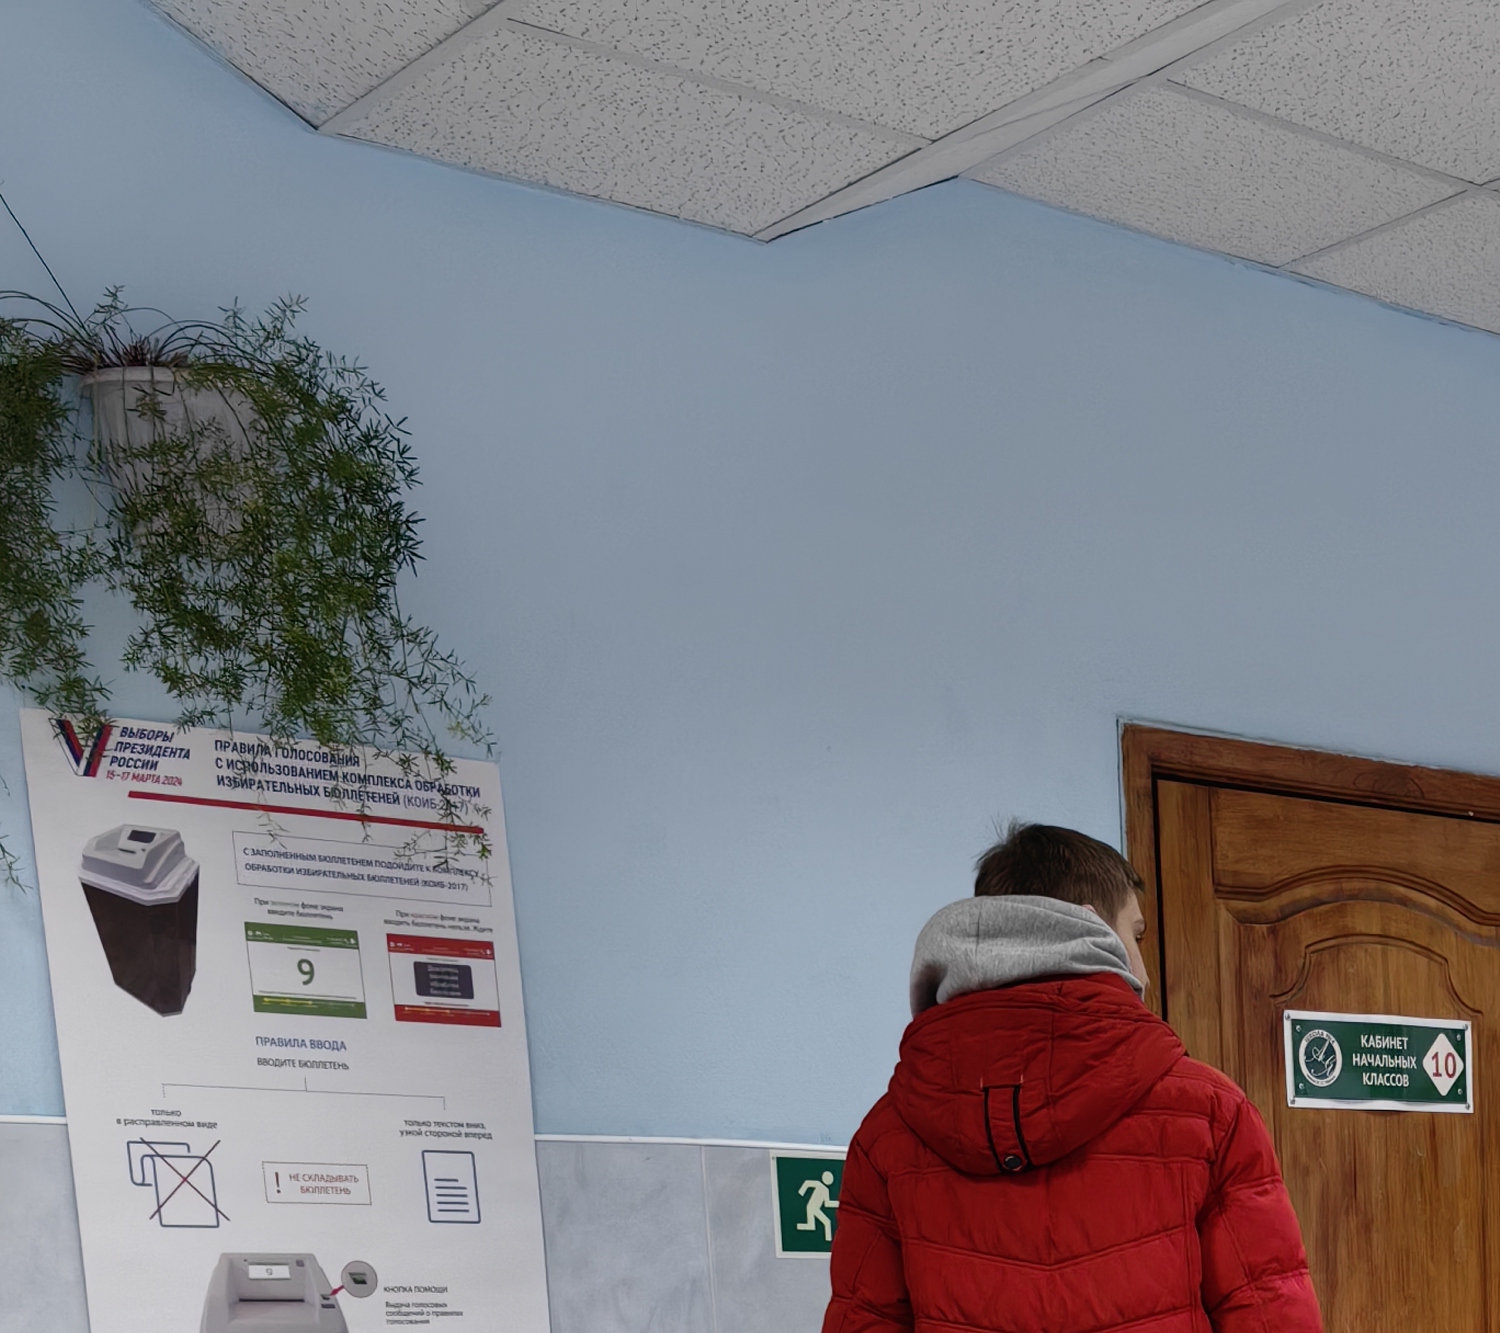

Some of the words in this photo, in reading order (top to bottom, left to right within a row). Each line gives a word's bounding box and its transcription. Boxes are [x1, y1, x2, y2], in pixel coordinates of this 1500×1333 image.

[119, 726, 175, 743] ВЫБОРЫ
[114, 741, 191, 760] ПРЕЗИДЕНТА
[214, 739, 272, 758] ПРАВИЛА
[275, 746, 360, 768] ГОЛОСОВАНИЯ
[109, 755, 160, 771] РОССИИ
[131, 772, 161, 785] МАРТА
[161, 775, 183, 787] 2024
[215, 757, 223, 769] С
[226, 758, 339, 783] ИСПОЛЬЗОВАНИЕМ
[341, 769, 413, 791] КОМПЛЕКСА
[414, 780, 481, 798] ОБРАБОТКИ
[216, 774, 320, 798] ИЗБИРАТЕЛЬНЫХ
[323, 786, 401, 806] БЮЛЛЕТЕНЕЙ
[250, 847, 317, 863] ЗАПОЛНЕННЫМ
[374, 859, 425, 872] ПОДОЙДИТЕ
[245, 863, 295, 874] ОБРАБОТКИ
[295, 867, 366, 882] ИЗБИРАТЕЛЬНЫХ
[366, 873, 420, 887] БЮЛЛЕТЕНЕЙ
[297, 958, 315, 986] 9
[255, 1036, 307, 1050] ПРАВИЛА
[309, 1039, 347, 1052] ВВОДА
[1360, 1034, 1409, 1050] КАБИНЕТ
[256, 1057, 296, 1069] ВВОДИТЕ
[298, 1058, 350, 1070] БЮЛЛЕТЕНЬ
[1352, 1053, 1418, 1070] НАЧАЛЬНЫХ
[1431, 1051, 1457, 1079] 10
[1362, 1072, 1410, 1087] КЛАССОВ
[288, 1173, 300, 1182] НЕ
[301, 1173, 360, 1184] СКЛАДЫВАТЬ
[299, 1185, 352, 1195] БЮЛЛЕТЕНЬ
